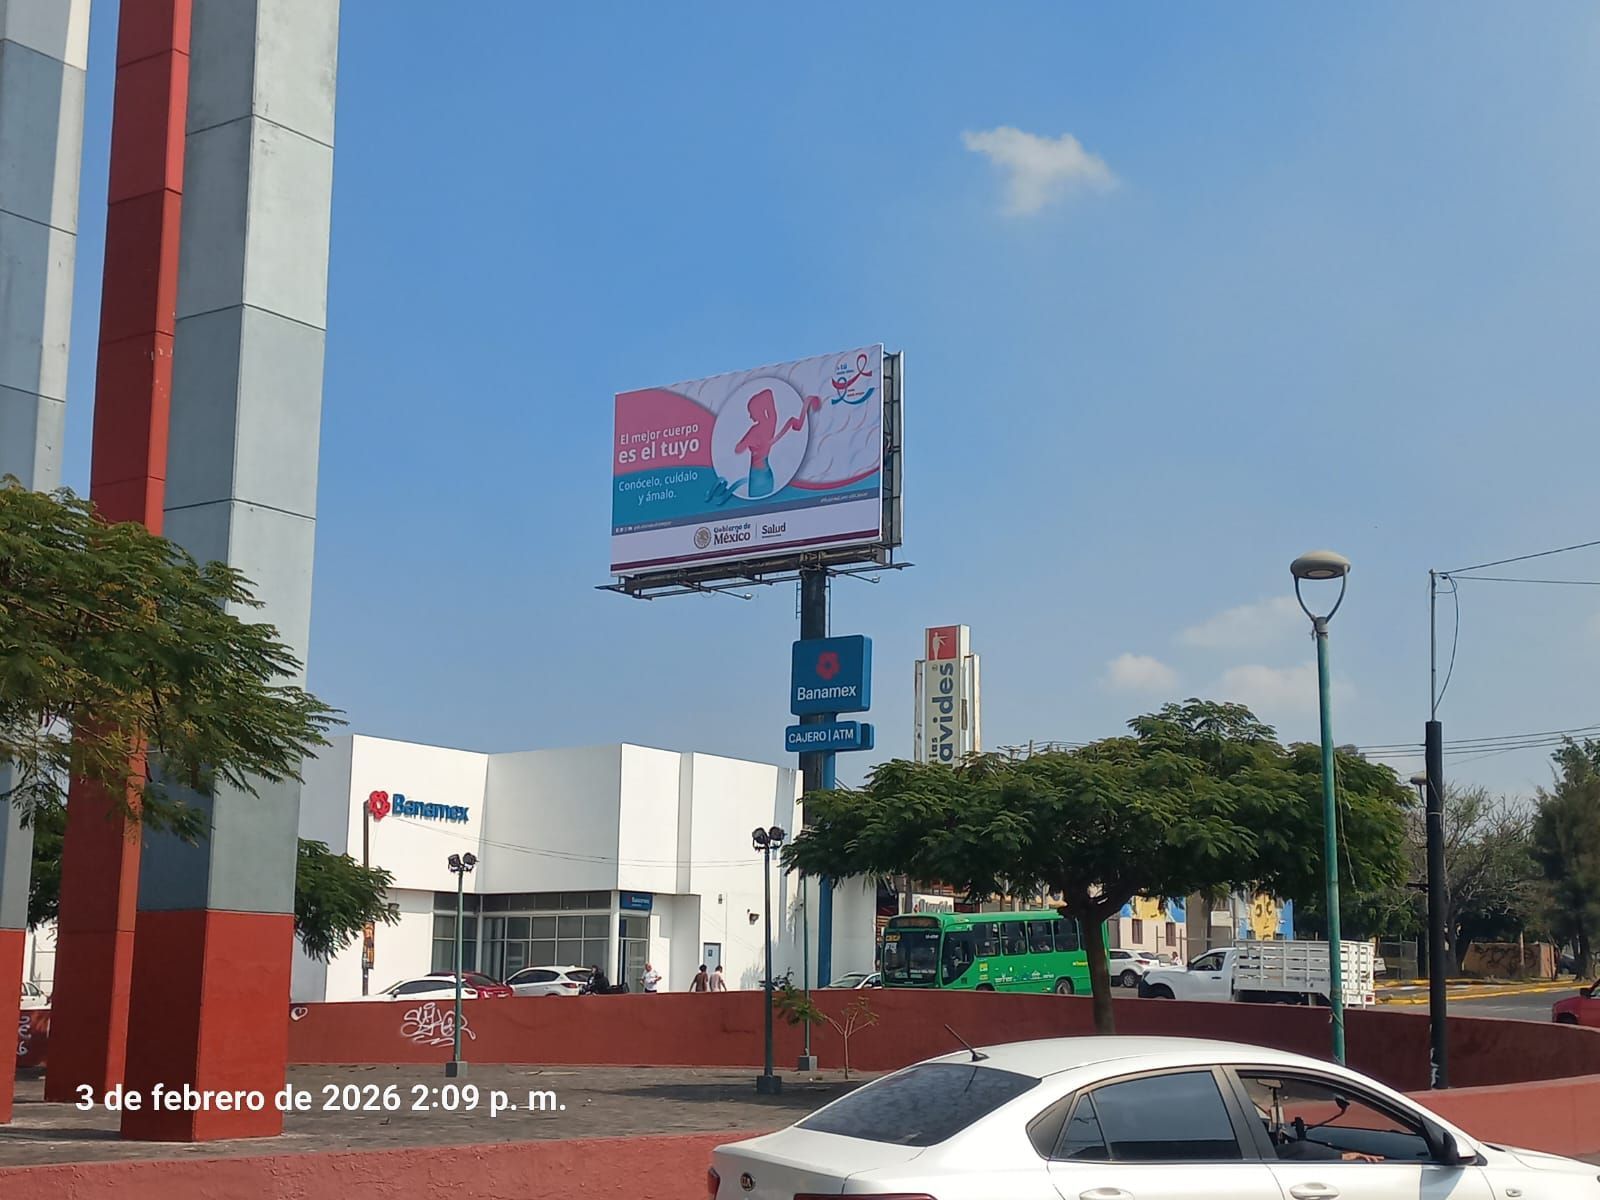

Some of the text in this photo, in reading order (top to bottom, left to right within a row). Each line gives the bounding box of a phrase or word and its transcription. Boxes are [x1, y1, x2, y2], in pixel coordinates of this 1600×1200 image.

[620, 424, 699, 445] El mejor cuerpo
[618, 438, 699, 464] es el tuyo
[618, 470, 698, 492] Conócelo, cuídalo
[638, 489, 677, 506] y ámalo.
[713, 524, 742, 533] Gobierno
[761, 522, 786, 534] Salud
[713, 530, 751, 545] México
[797, 685, 857, 701] Banamex
[932, 662, 954, 768] avides
[788, 728, 854, 743] CAJERO ATM
[392, 793, 470, 824] Banamex
